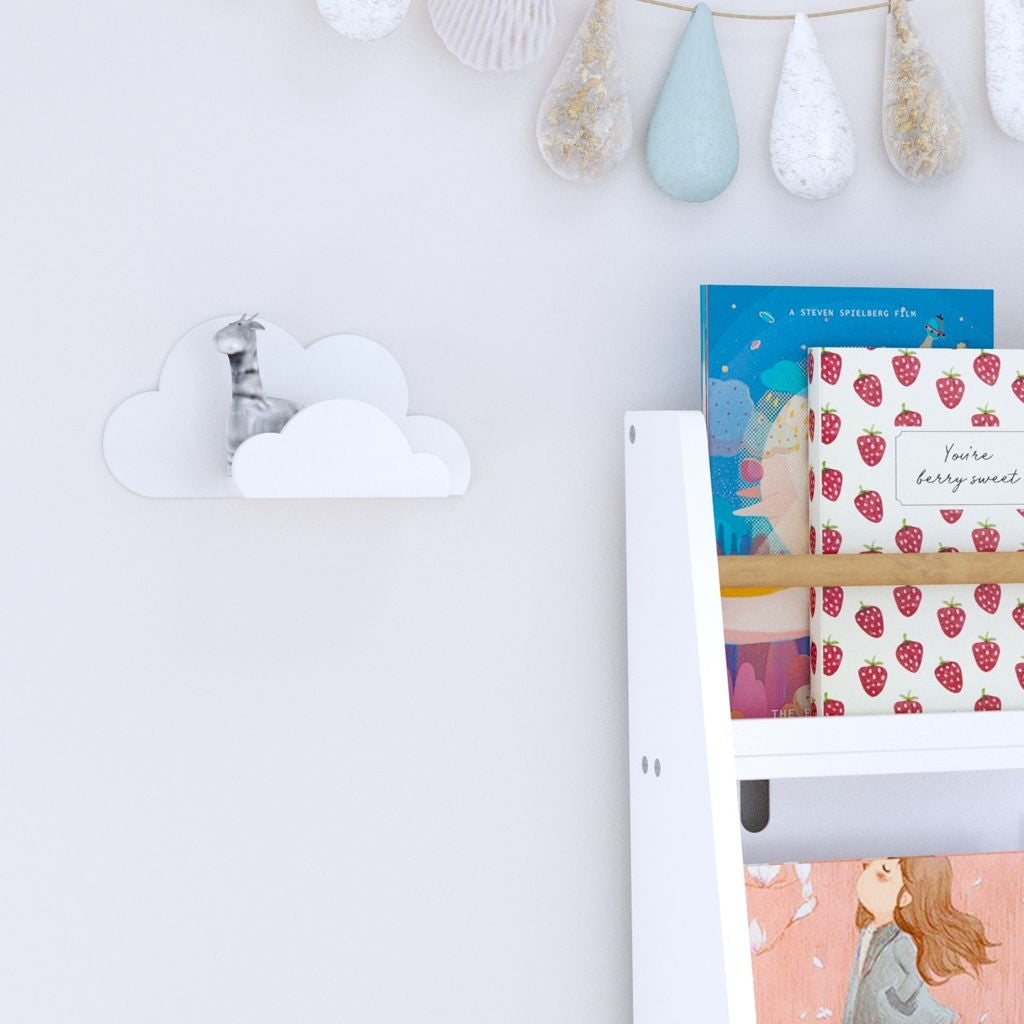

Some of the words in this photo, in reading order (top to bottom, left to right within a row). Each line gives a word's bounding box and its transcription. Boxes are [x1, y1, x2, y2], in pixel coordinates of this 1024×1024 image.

[789, 308, 795, 316] A
[800, 308, 834, 317] STEVEN
[839, 309, 889, 317] SPIELBERG
[894, 309, 917, 318] FILM
[944, 443, 994, 463] You're
[916, 469, 967, 494] berry
[970, 469, 1022, 485] sweet
[771, 709, 795, 718] THE
